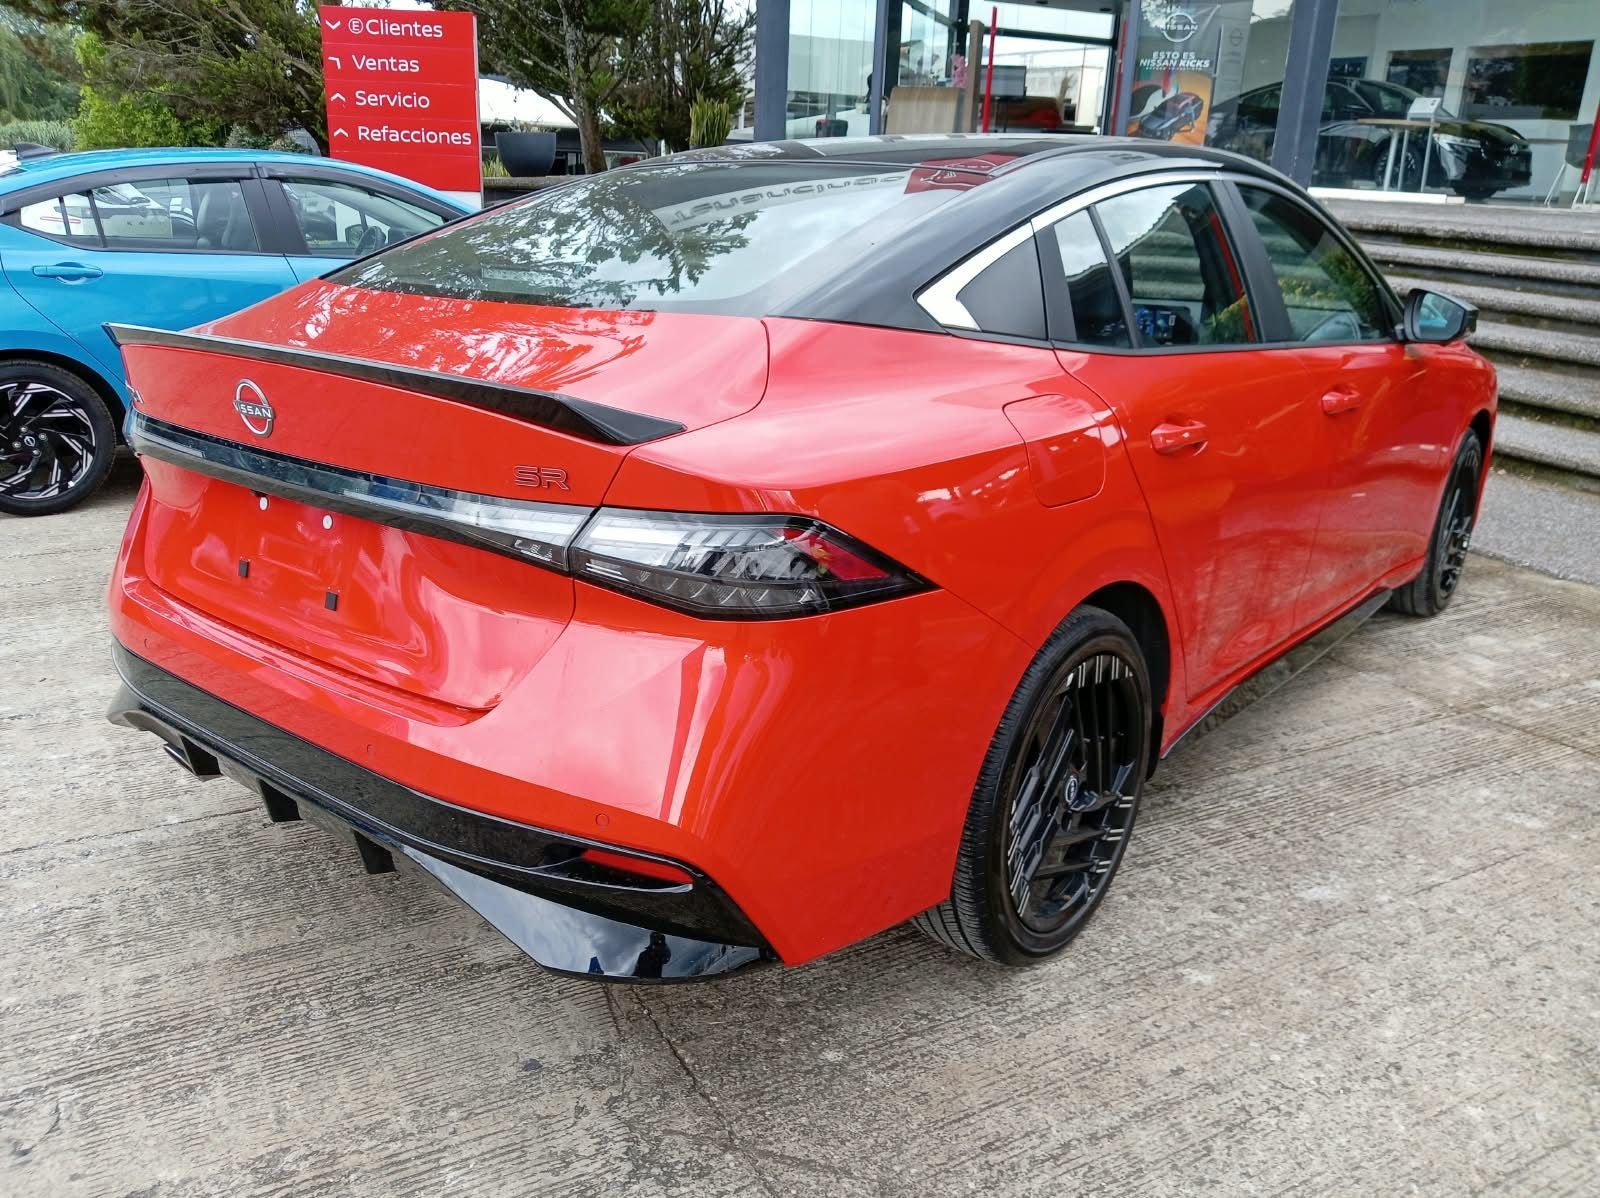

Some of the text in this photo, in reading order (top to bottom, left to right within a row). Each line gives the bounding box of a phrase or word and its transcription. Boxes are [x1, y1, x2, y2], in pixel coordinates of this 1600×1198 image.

[366, 19, 443, 38] Clientes
[352, 54, 420, 73] Ventas
[1140, 59, 1210, 68] NISSAN KICKS
[1152, 51, 1196, 60] ESTO ES
[355, 90, 430, 109] Servicio
[358, 126, 472, 145] Refacciones
[513, 465, 569, 490] SR
